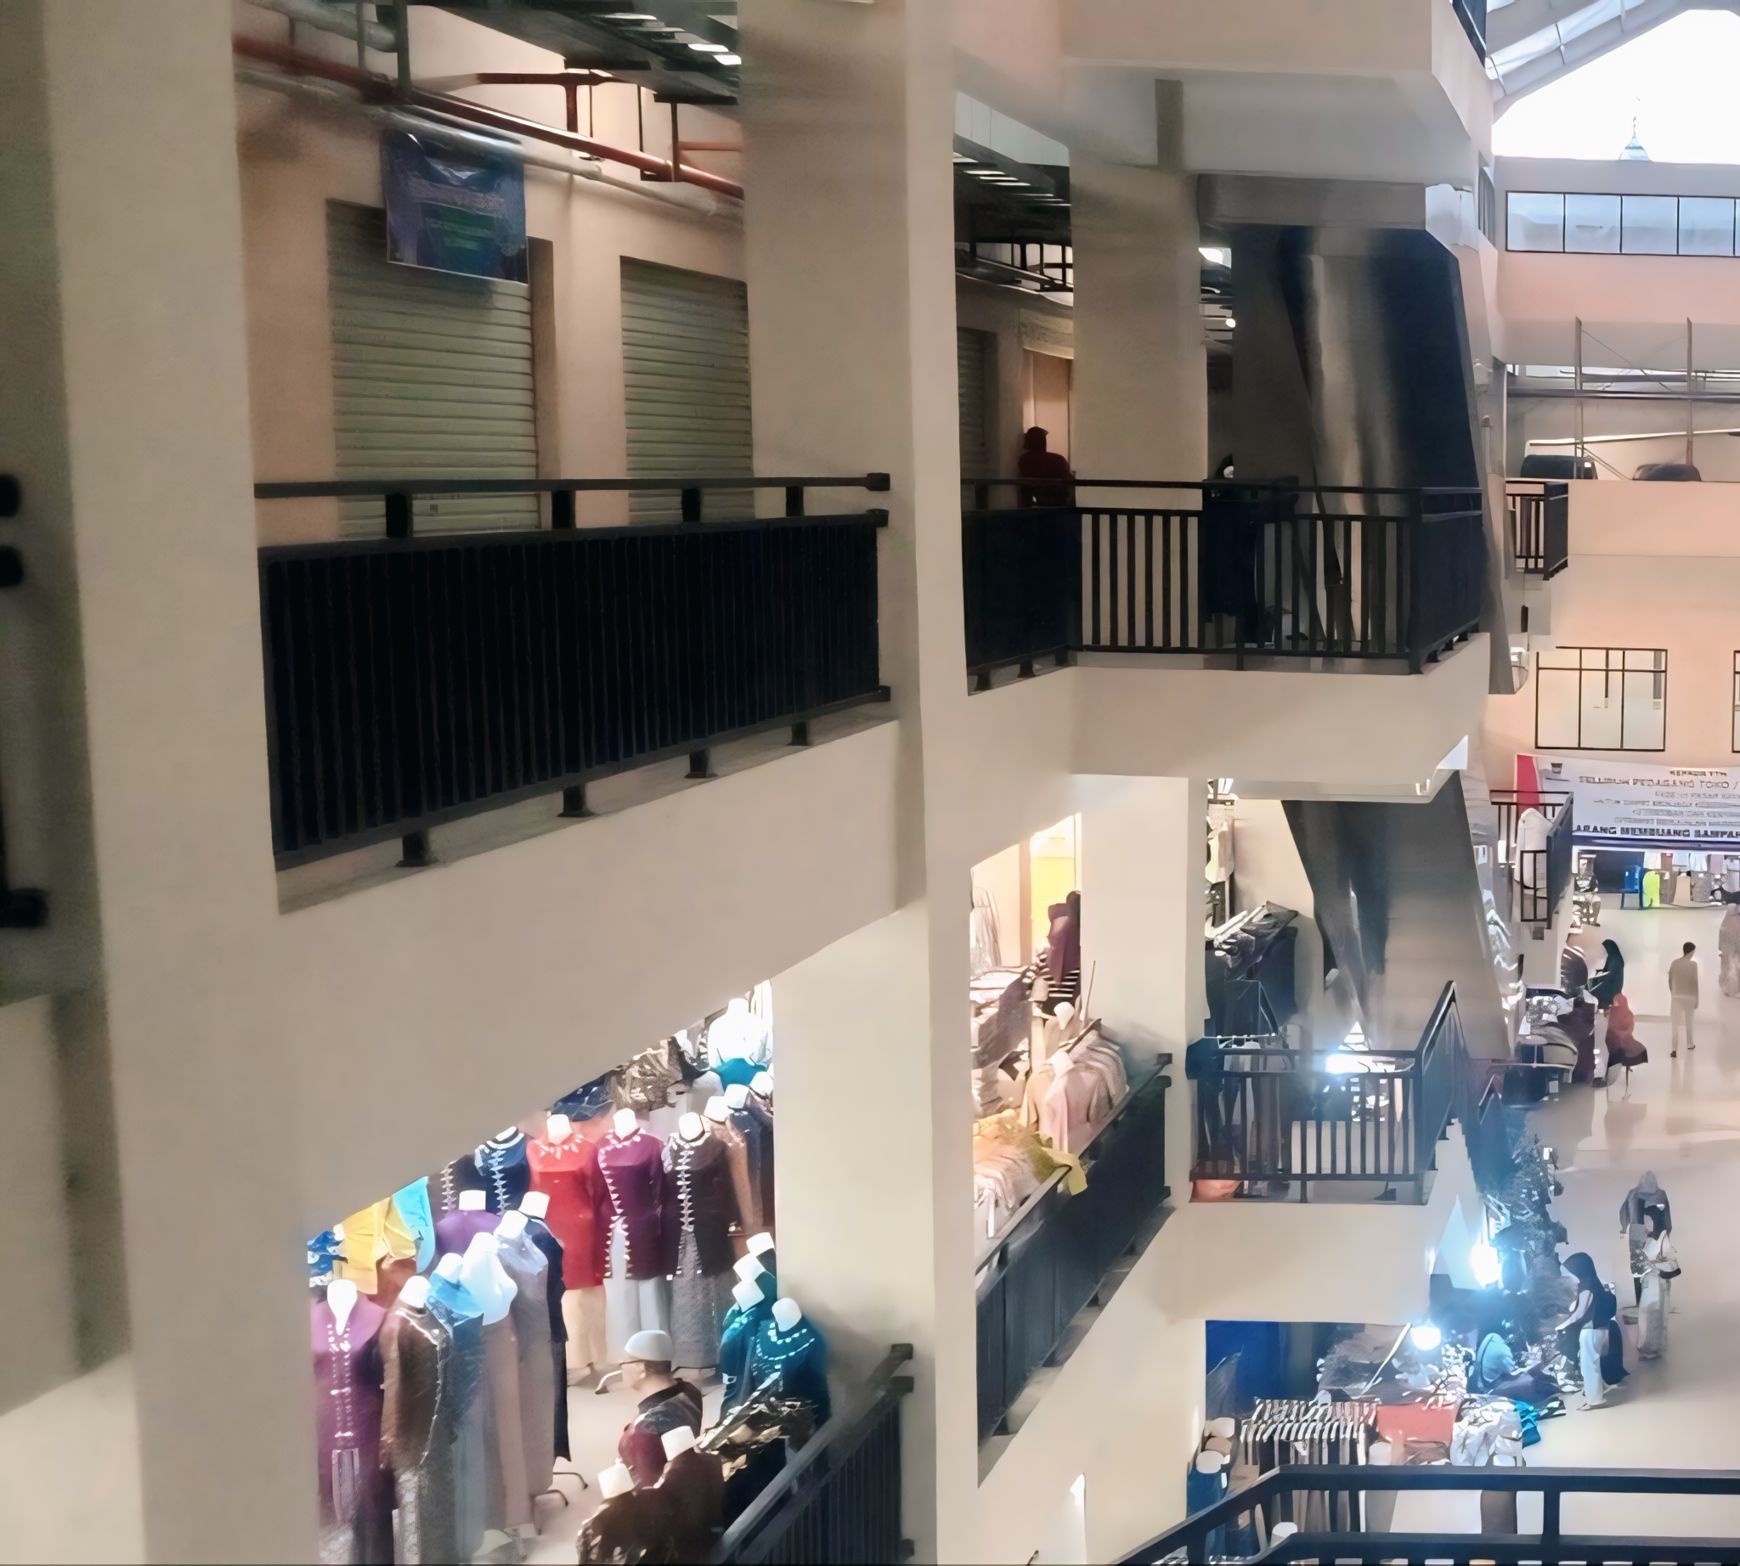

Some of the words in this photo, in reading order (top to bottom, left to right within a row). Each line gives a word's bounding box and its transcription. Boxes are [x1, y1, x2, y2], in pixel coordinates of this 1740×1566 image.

[1632, 777, 1695, 789] PEDAGANG
[1699, 779, 1730, 790] TOKO
[1620, 826, 1691, 839] MEMBUANG
